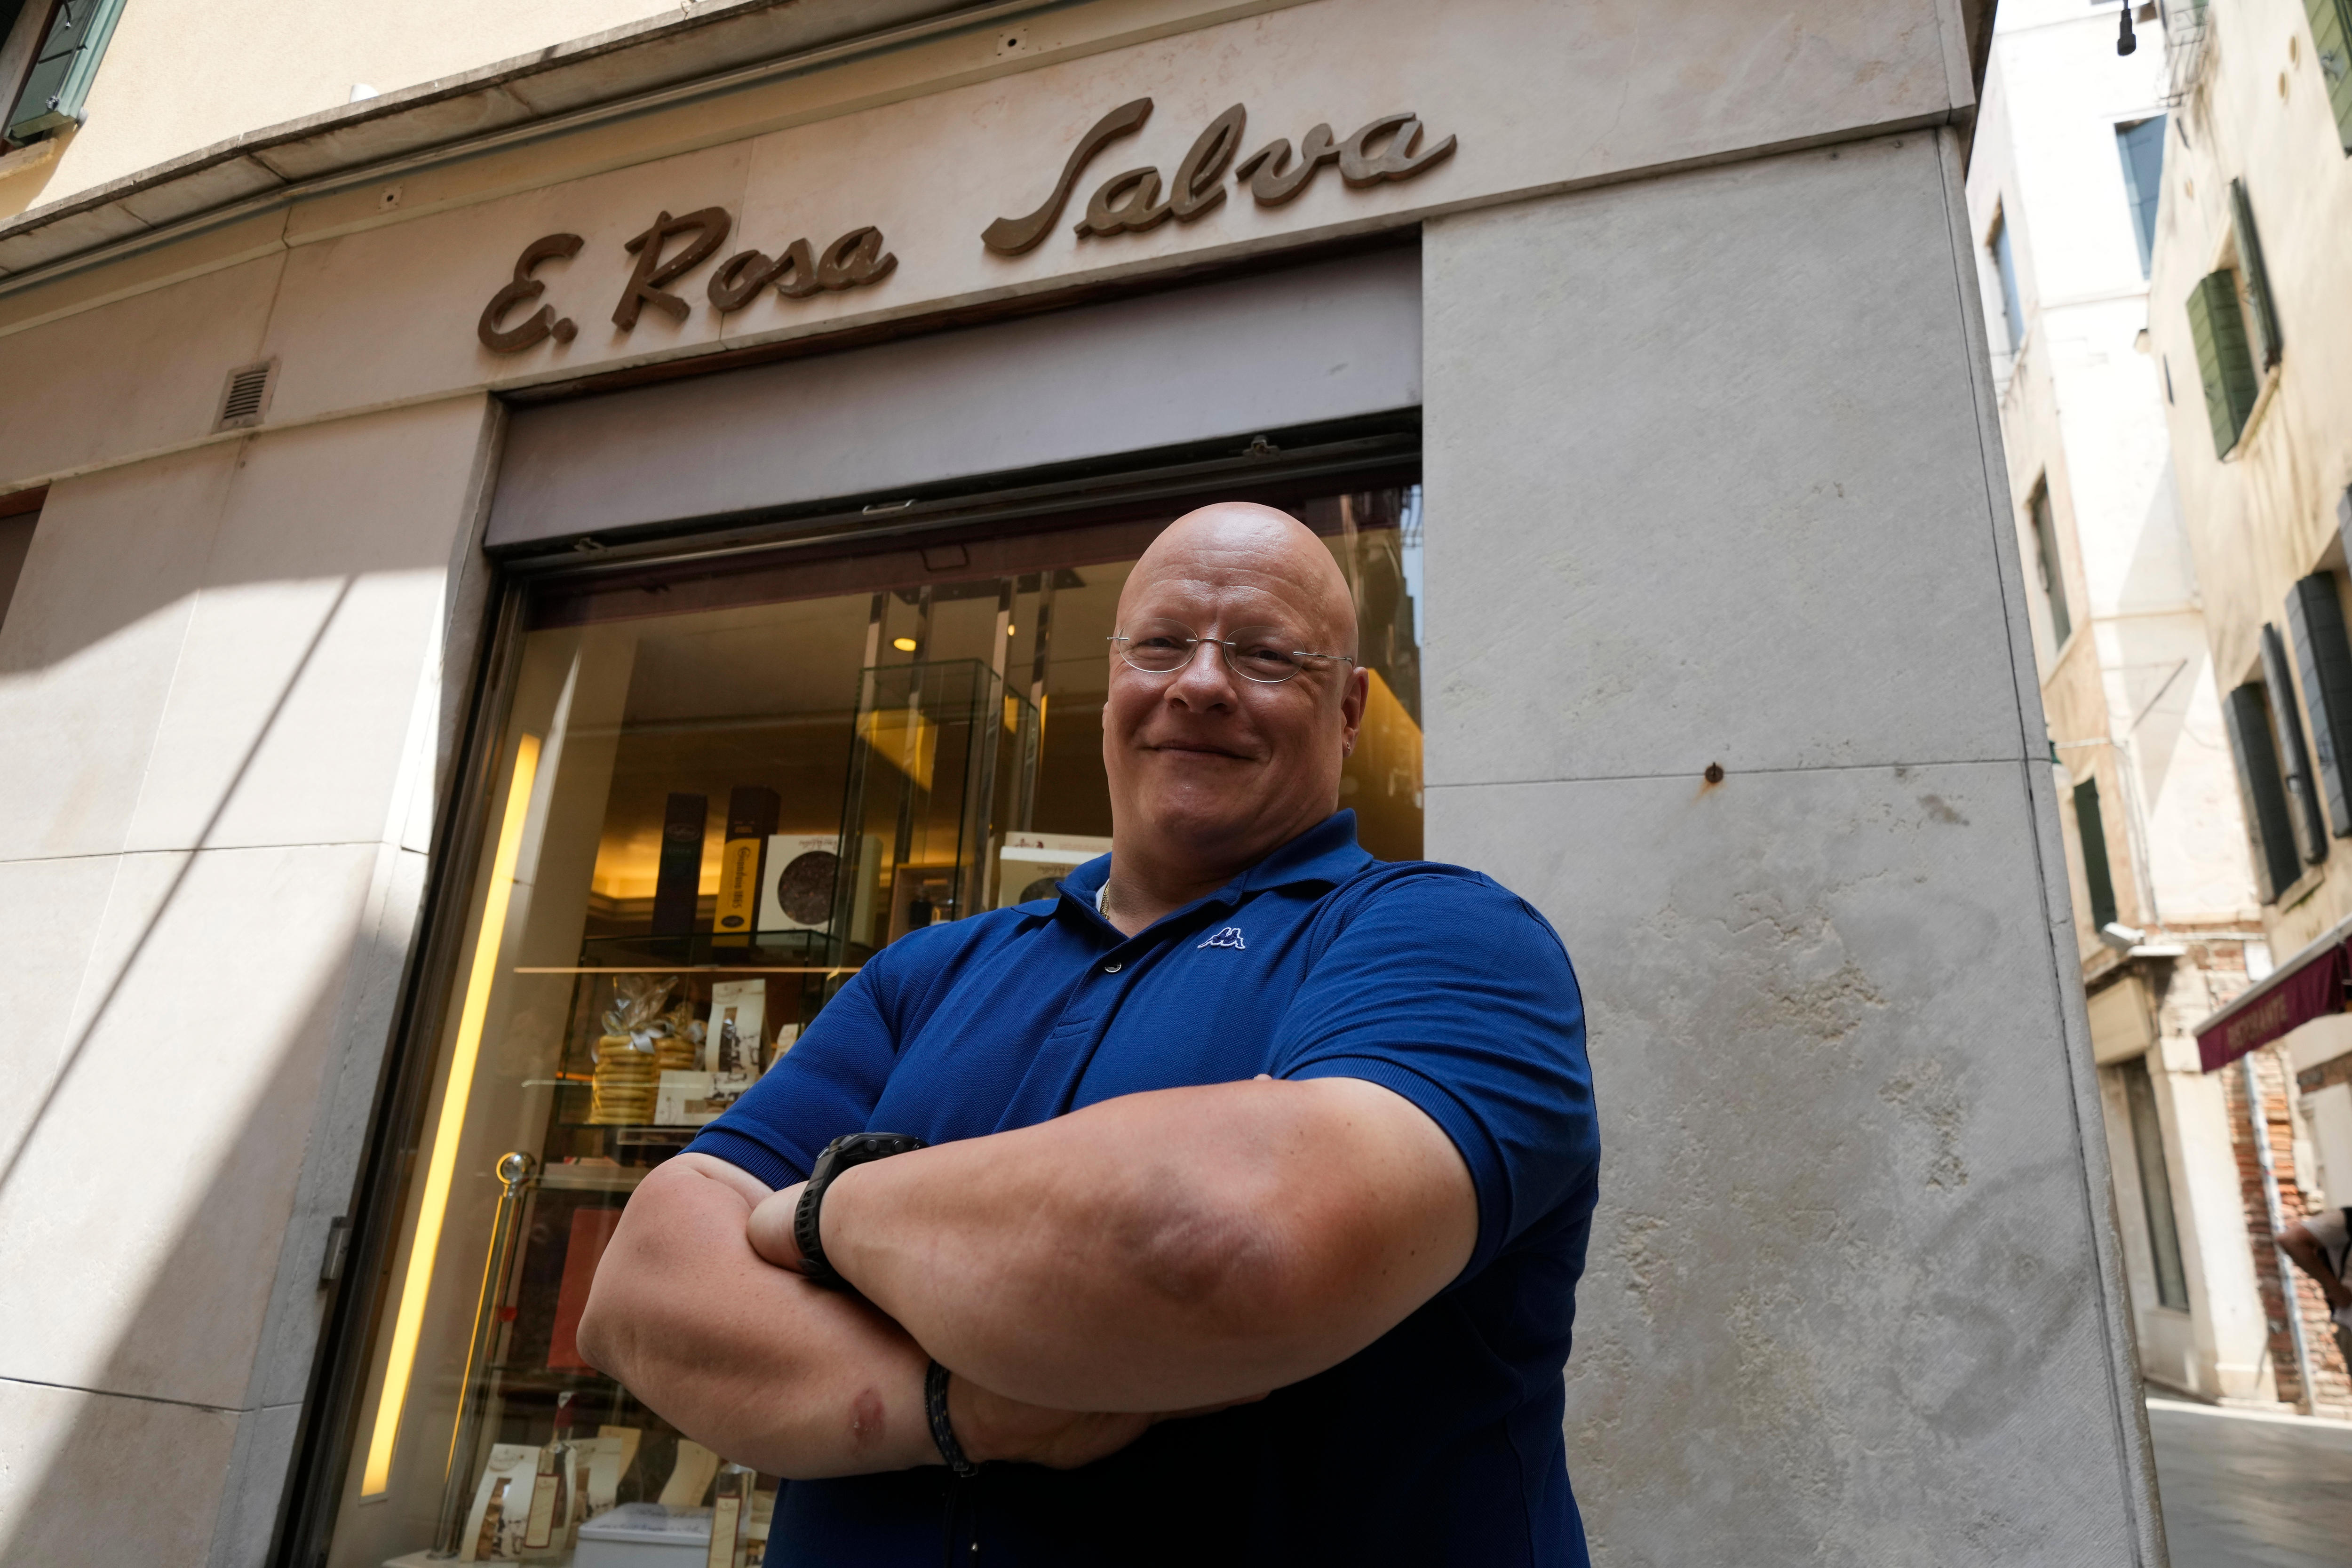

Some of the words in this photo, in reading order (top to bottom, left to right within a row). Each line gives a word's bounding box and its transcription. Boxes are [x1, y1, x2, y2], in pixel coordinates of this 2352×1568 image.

[477, 233, 584, 353] E.
[611, 207, 899, 333] Rosa
[980, 97, 1458, 256] Salva
